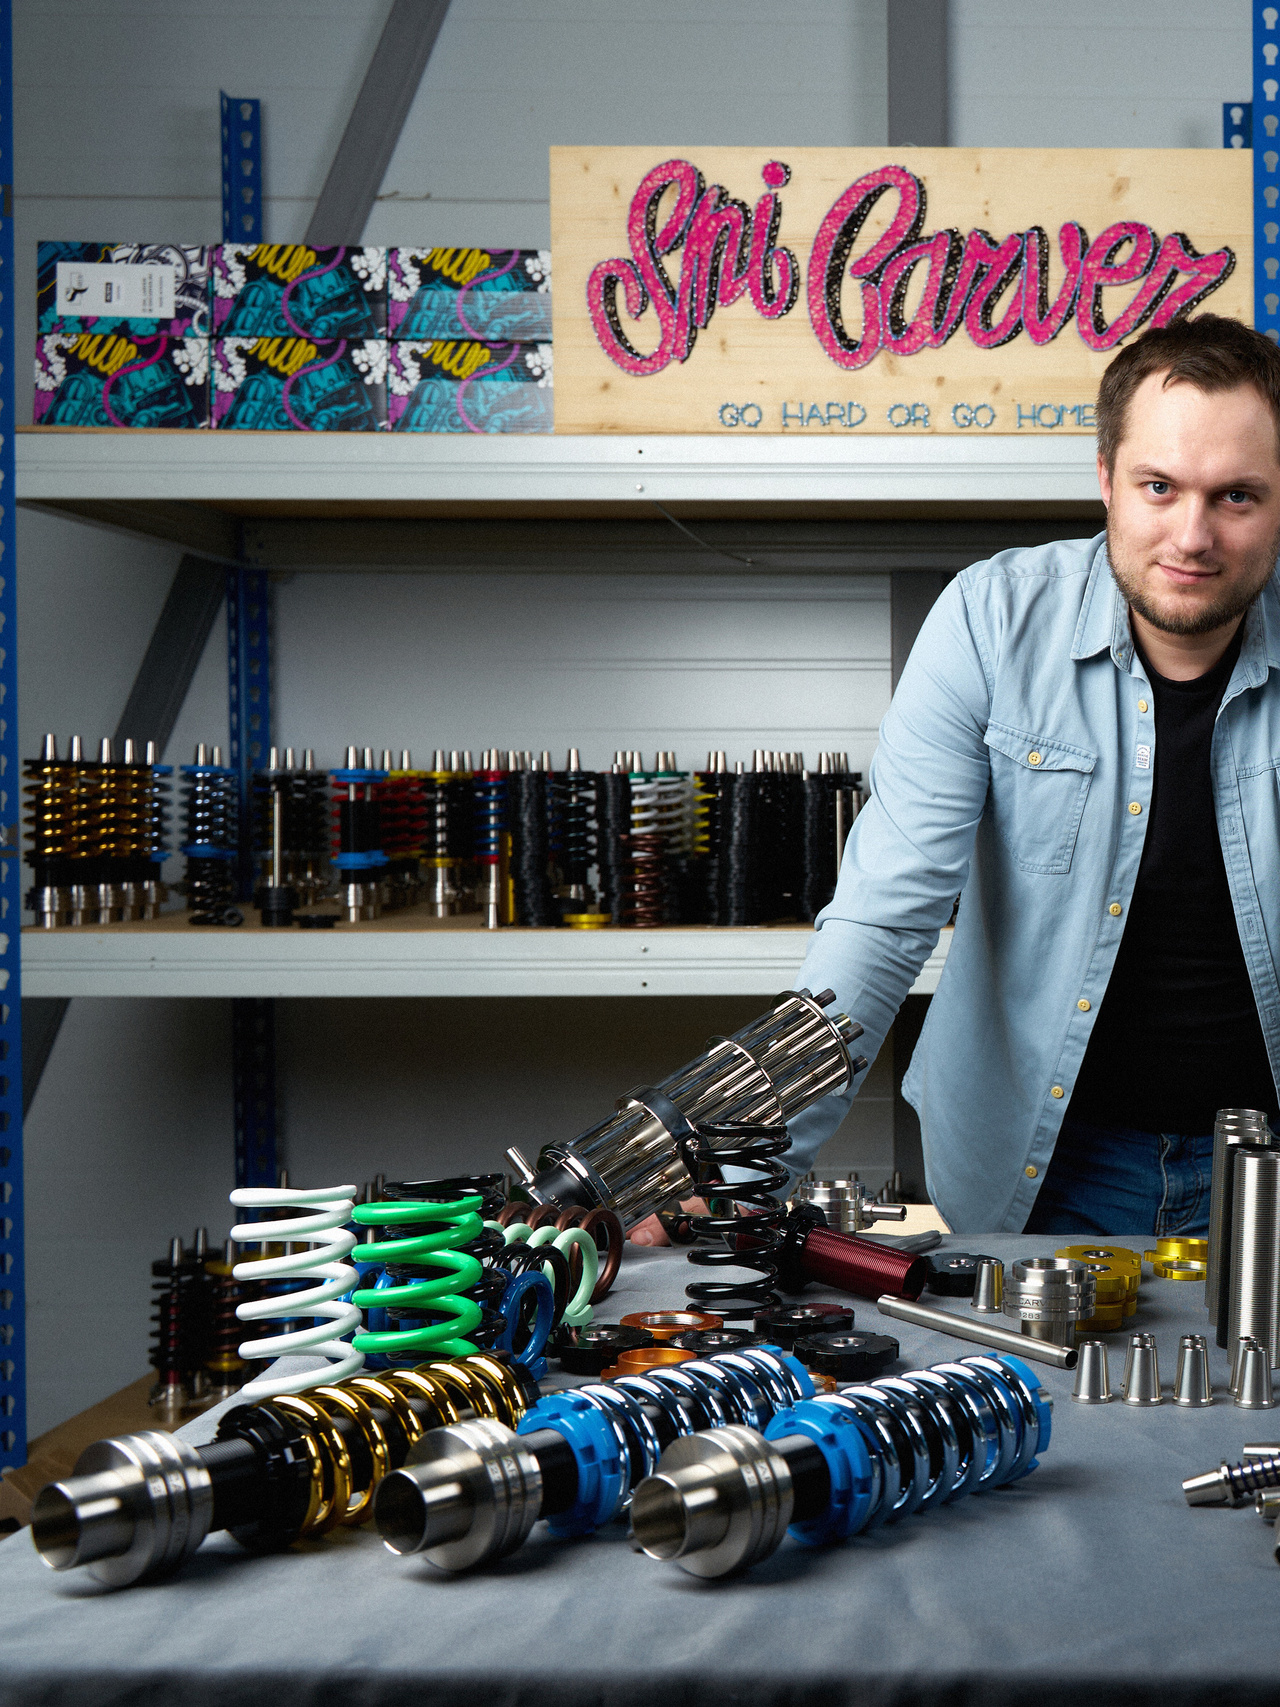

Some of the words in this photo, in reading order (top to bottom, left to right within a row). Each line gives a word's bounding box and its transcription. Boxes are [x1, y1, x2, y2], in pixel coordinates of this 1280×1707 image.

[718, 402, 762, 428] GO
[781, 401, 867, 428] HARD
[886, 402, 930, 428] OR
[951, 402, 996, 428] GO
[1016, 402, 1098, 429] HOME
